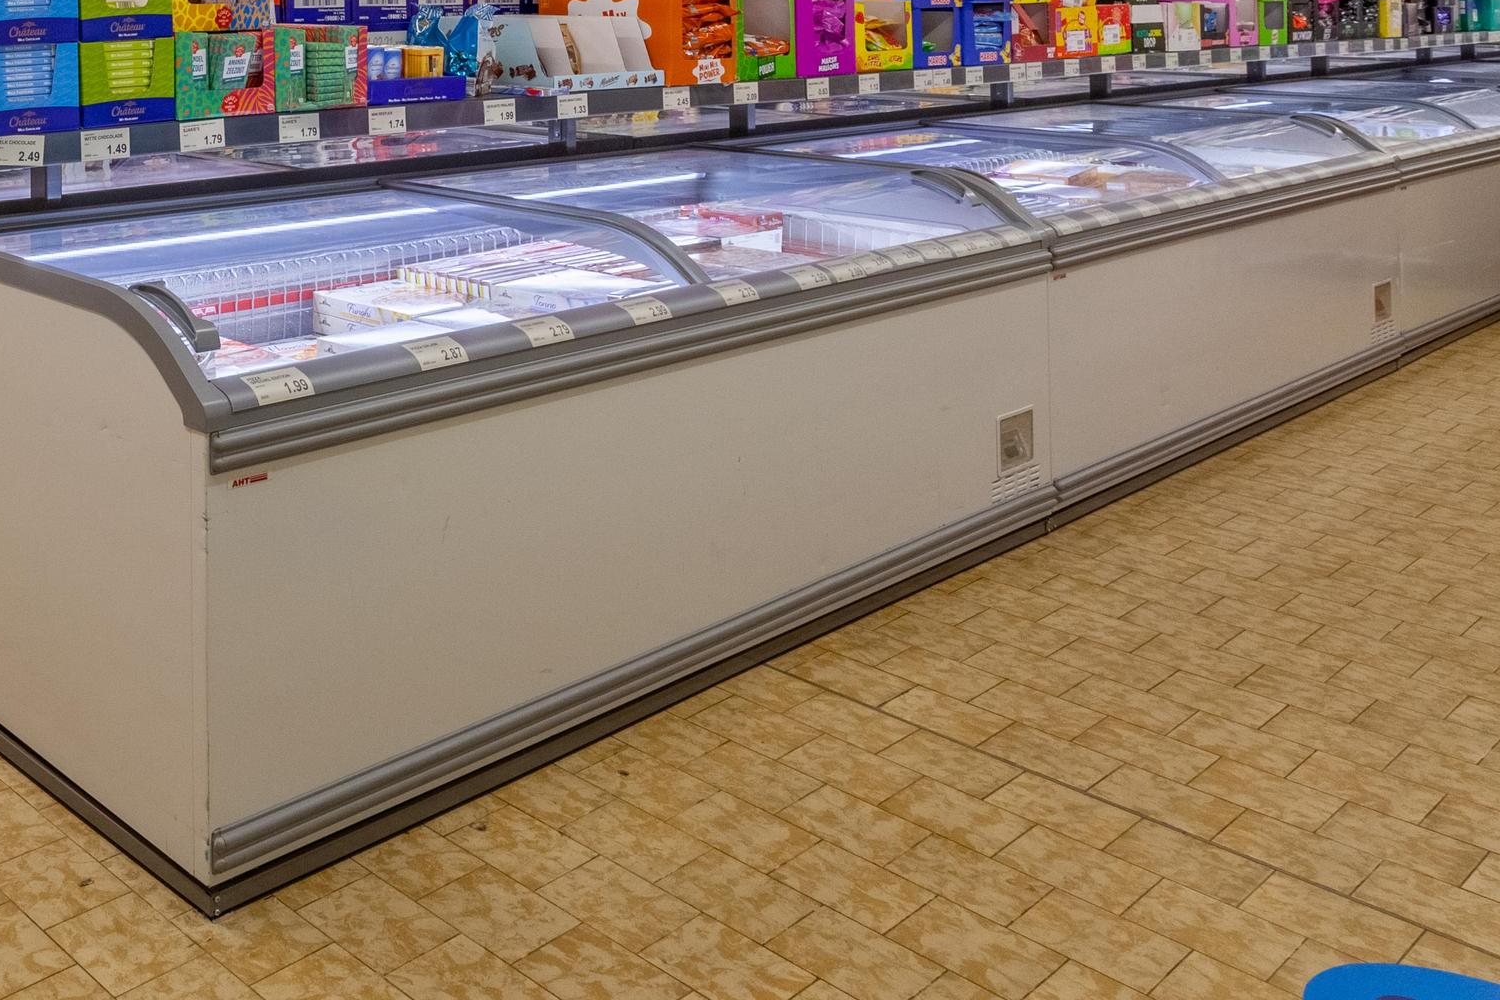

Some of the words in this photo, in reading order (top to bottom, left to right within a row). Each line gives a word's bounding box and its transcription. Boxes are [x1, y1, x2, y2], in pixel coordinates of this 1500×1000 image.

[9, 25, 47, 38] Château
[110, 21, 146, 33] Château
[927, 55, 947, 66] HARIBO
[980, 52, 998, 62] HARIBO
[699, 69, 720, 81] POWER
[676, 98, 689, 107] 2.45
[111, 105, 146, 118] Château
[500, 110, 514, 121] 1.99
[573, 105, 587, 115] 1.33
[8, 115, 47, 128] Château
[388, 119, 404, 129] 1.74
[300, 126, 318, 137] 1.79
[204, 134, 223, 145] 1.79
[107, 143, 127, 155] 1.49
[18, 151, 40, 162] 2.49
[533, 293, 557, 310] Tonno
[346, 302, 372, 319] Funghi
[549, 324, 570, 338] 2.79
[441, 346, 463, 362] 2.87
[283, 378, 309, 395] 1.99
[231, 477, 250, 488] AHT
